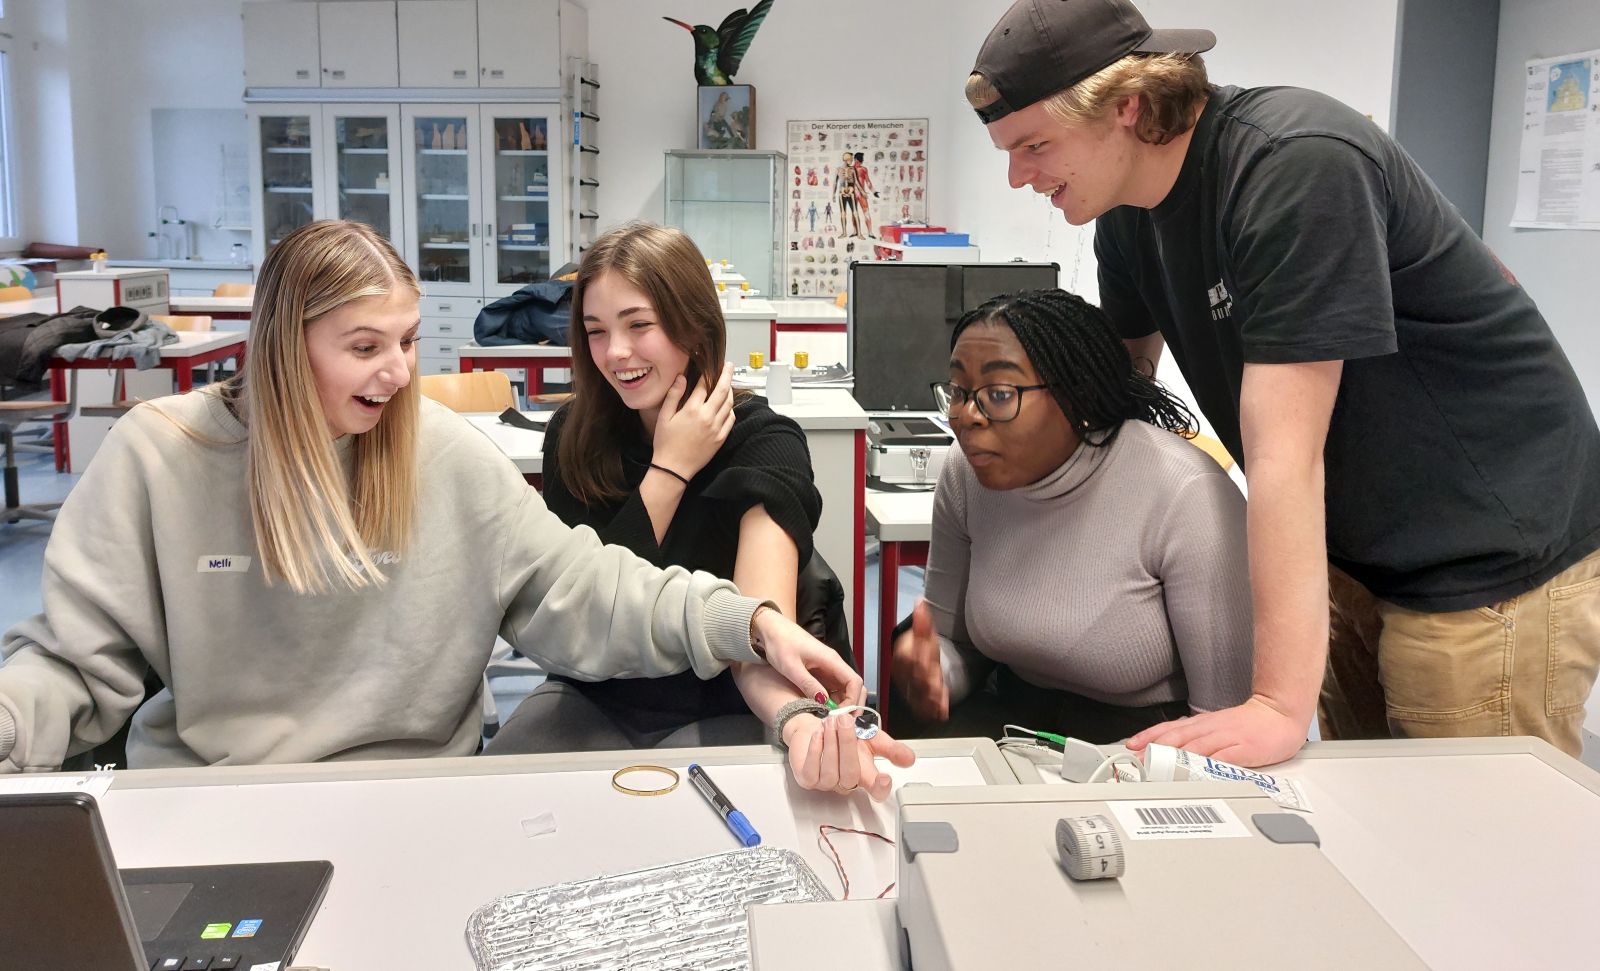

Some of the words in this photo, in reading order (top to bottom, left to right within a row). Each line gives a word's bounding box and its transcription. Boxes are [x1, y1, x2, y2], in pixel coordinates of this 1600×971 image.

[209, 557, 232, 569] Nelli
[1095, 834, 1105, 850] 5
[1100, 858, 1108, 873] 4
